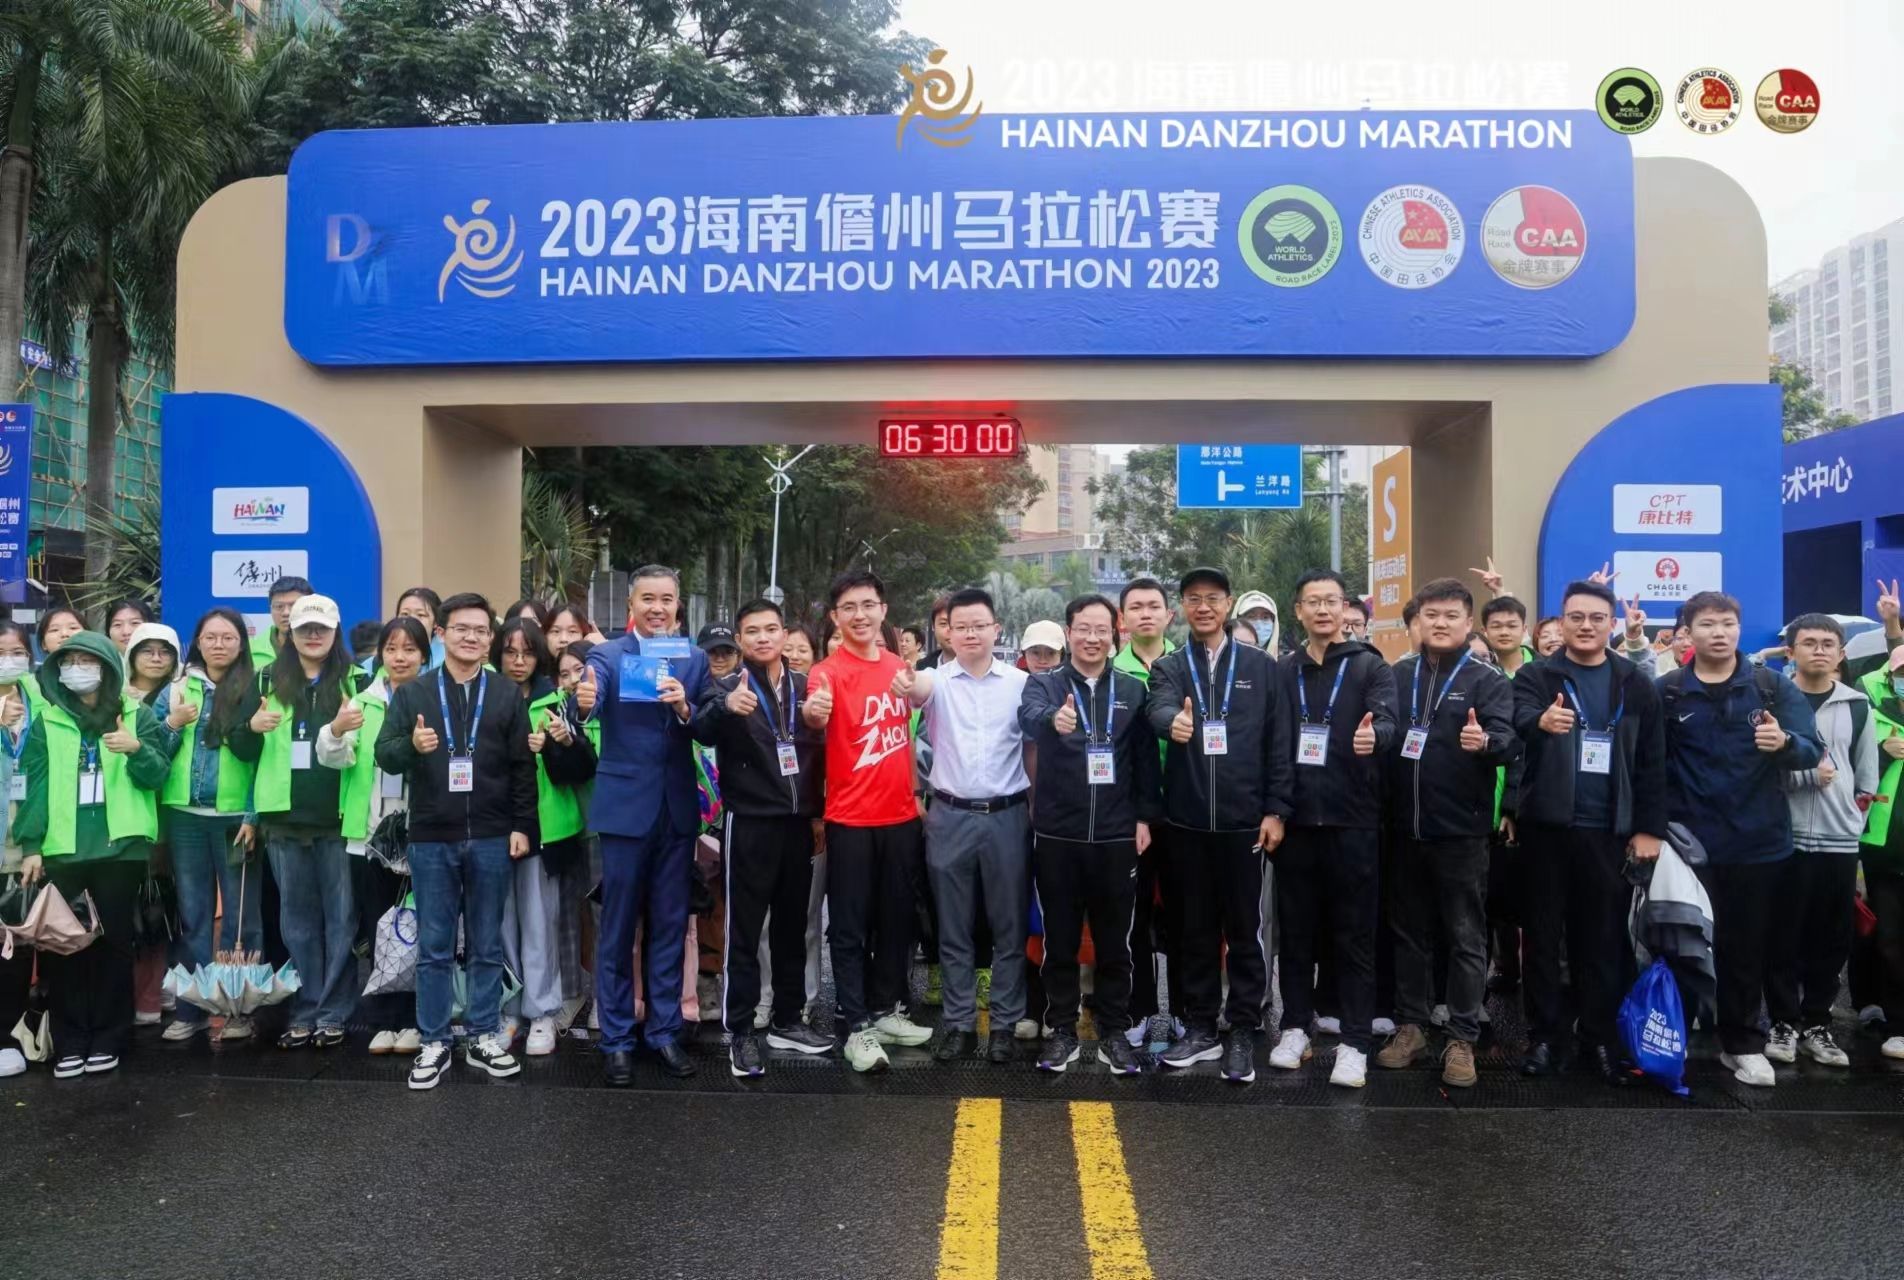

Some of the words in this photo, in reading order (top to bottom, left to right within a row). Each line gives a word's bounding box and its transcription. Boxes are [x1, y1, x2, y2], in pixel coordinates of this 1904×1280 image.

[1362, 206, 1382, 240] CHINESE
[1380, 187, 1424, 207] ATHLETICS
[1427, 193, 1462, 241] ASSOCIATION
[540, 189, 1221, 258] 2023海南儋州马拉松赛
[1487, 228, 1511, 237] Road
[1521, 228, 1578, 248] CAA
[1487, 240, 1511, 249] Race
[1267, 253, 1314, 262] ATHLETICS
[1503, 258, 1566, 274] 金牌赛事
[540, 264, 687, 297] HAINAN
[704, 260, 894, 294] DANZHOU
[909, 258, 1132, 290] MARATHON
[1147, 257, 1220, 289] 2023
[1275, 275, 1300, 284] ROAD
[1301, 269, 1323, 282] RACE
[886, 424, 921, 453] 06
[933, 424, 967, 453] 30
[976, 424, 1013, 453] 00
[1255, 475, 1291, 487] 兰洋路
[1383, 475, 1396, 542] S
[1649, 494, 1687, 508] CPT
[233, 502, 285, 517] HAINAN
[1638, 510, 1694, 526] 康比特
[1647, 583, 1688, 591] CHAGEE
[861, 692, 908, 727] DAN
